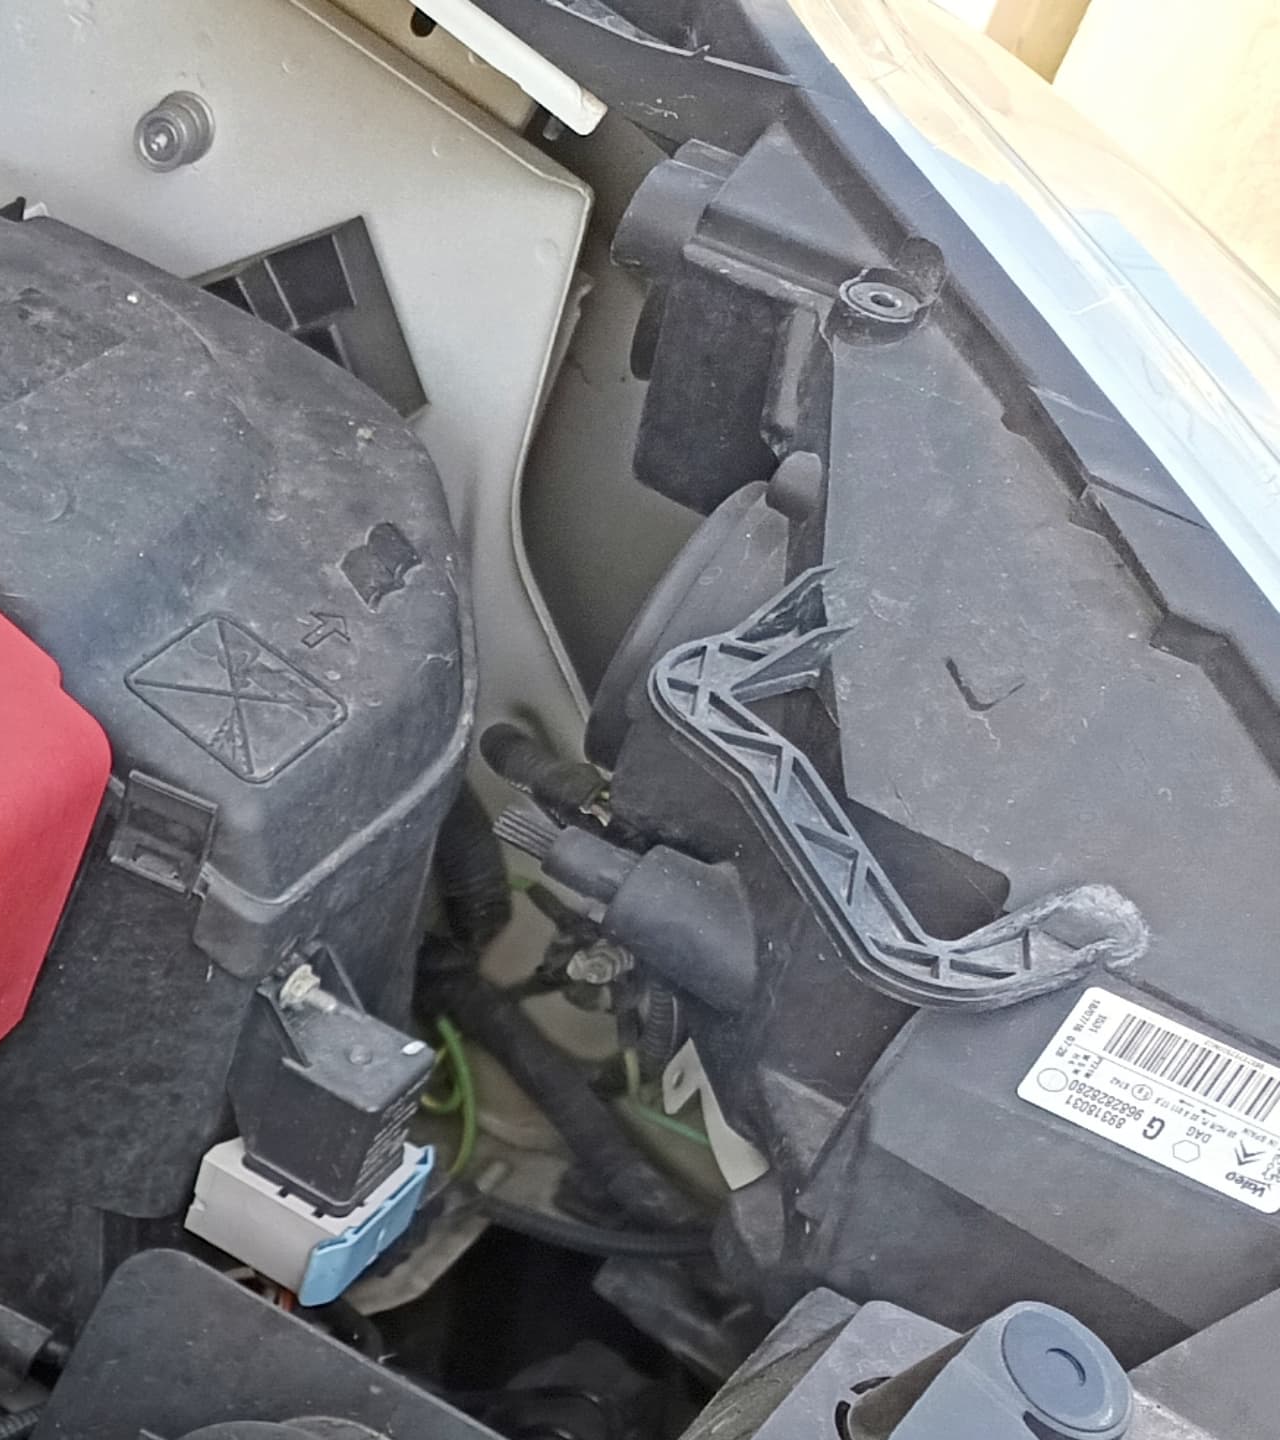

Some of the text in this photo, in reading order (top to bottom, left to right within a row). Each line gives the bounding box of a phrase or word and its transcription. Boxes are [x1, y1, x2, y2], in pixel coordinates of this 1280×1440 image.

[1064, 1092, 1126, 1130] 89318031
[1067, 1076, 1144, 1122] 9682828280
[1140, 1114, 1167, 1143] G
[1185, 1124, 1212, 1145] DAG
